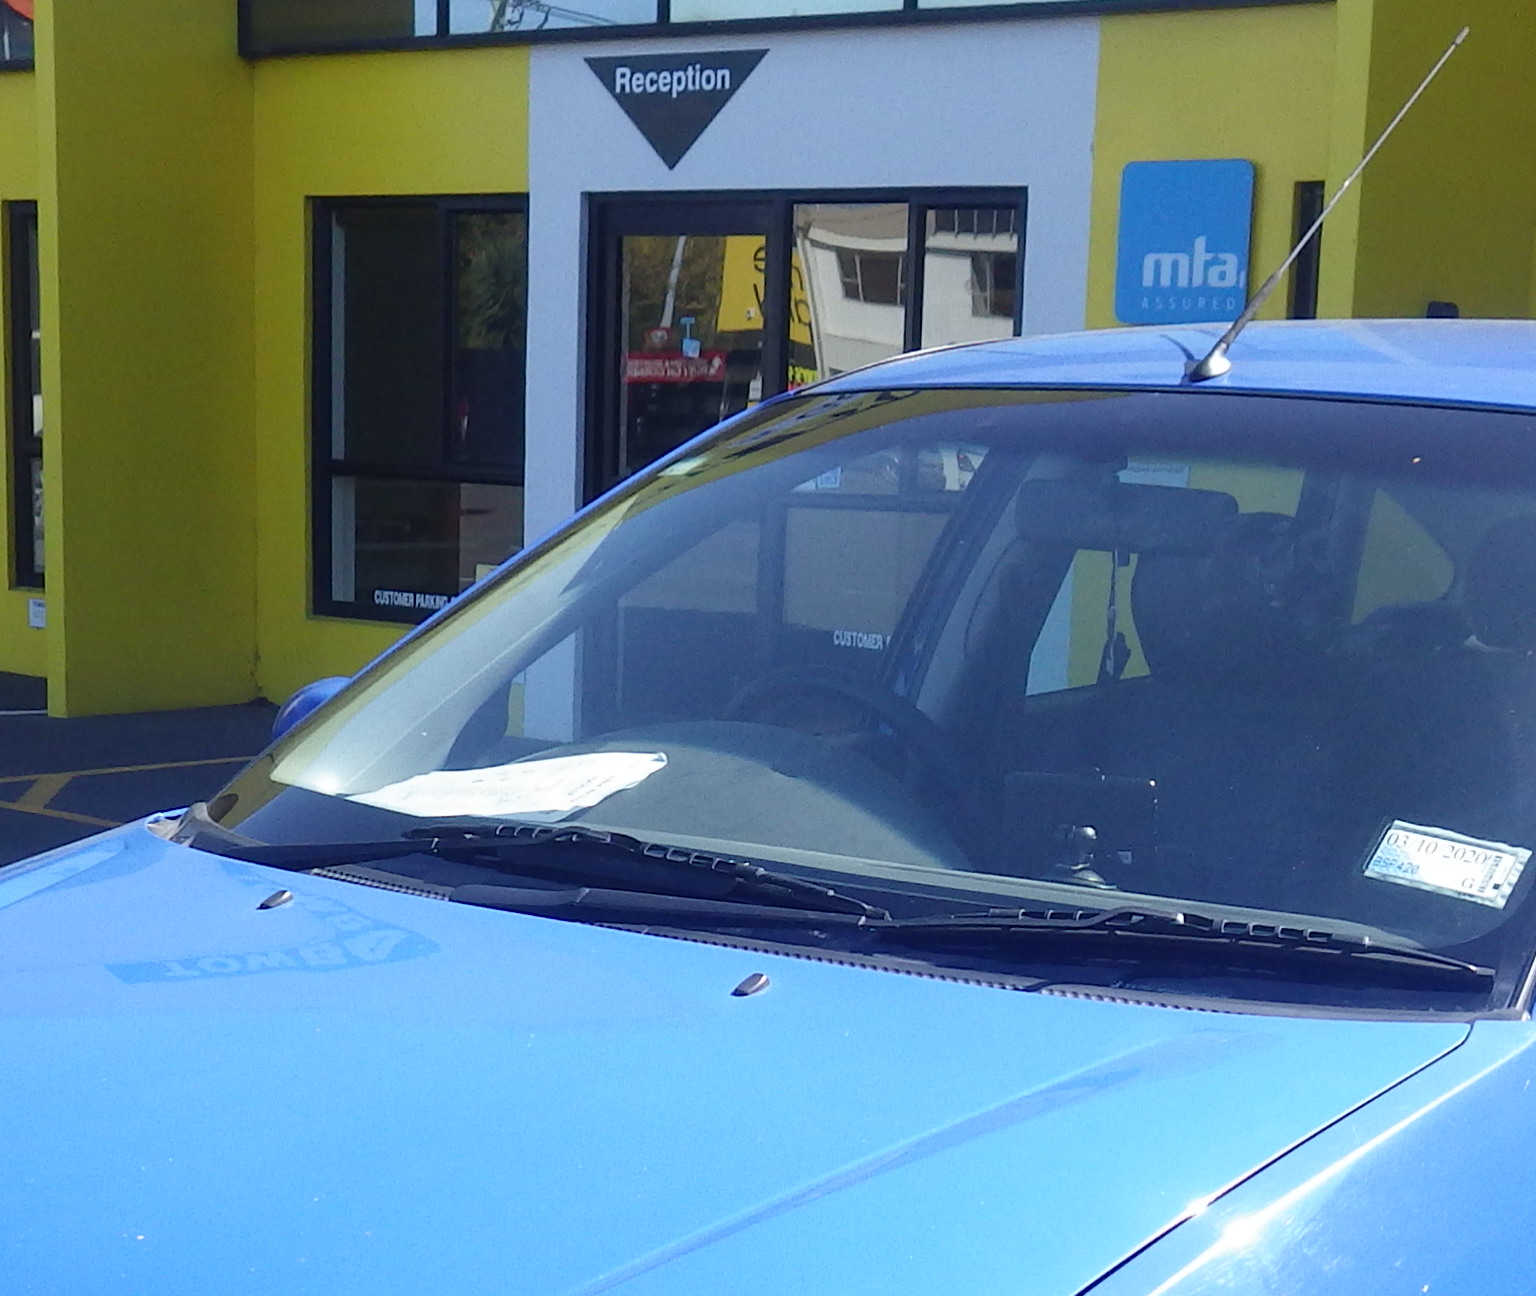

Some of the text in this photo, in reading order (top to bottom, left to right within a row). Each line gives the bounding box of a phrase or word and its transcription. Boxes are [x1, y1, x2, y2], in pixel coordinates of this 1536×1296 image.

[615, 63, 730, 98] Reception
[1142, 235, 1238, 288] mta
[1141, 297, 1237, 310] ASSURED
[374, 590, 414, 607] CUSTOMER
[833, 630, 883, 650] CUSTOMER
